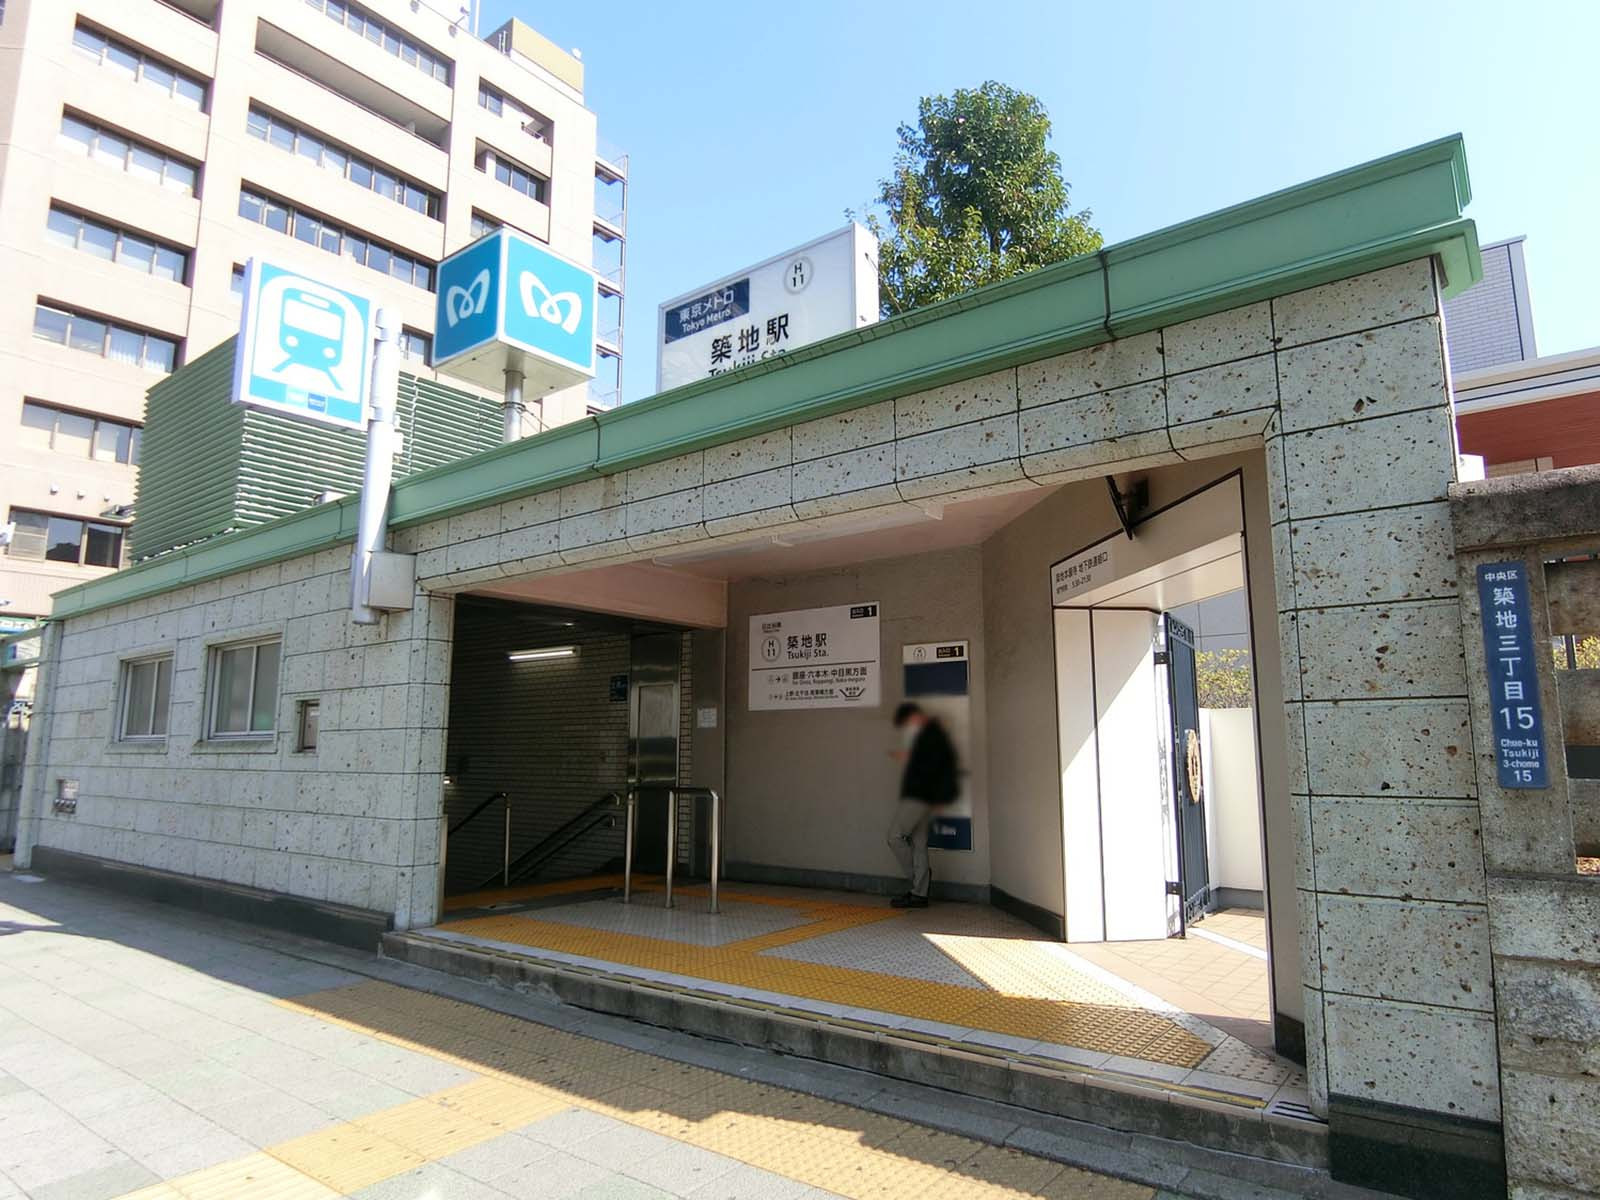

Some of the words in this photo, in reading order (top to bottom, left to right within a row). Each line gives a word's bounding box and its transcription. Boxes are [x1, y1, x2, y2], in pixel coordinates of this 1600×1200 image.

[794, 262, 803, 274] H
[792, 274, 804, 287] 11
[680, 290, 734, 322] 東京メトロ
[682, 320, 705, 333] Tokyo
[706, 308, 731, 325] Metro
[711, 313, 789, 365] 築地駅
[1484, 570, 1518, 582] 中央区
[867, 606, 872, 616] 1
[787, 633, 827, 649] 築地駅
[1493, 587, 1524, 700] 築地三丁目
[767, 648, 776, 656] 11
[787, 650, 812, 660] Tsukiji
[954, 647, 959, 656] 1
[1500, 706, 1535, 730] 15
[1500, 738, 1538, 748] Chuo-ku
[1502, 748, 1540, 759] Tsukiji
[1503, 759, 1540, 768] 3-chome
[1514, 769, 1533, 782] 15
